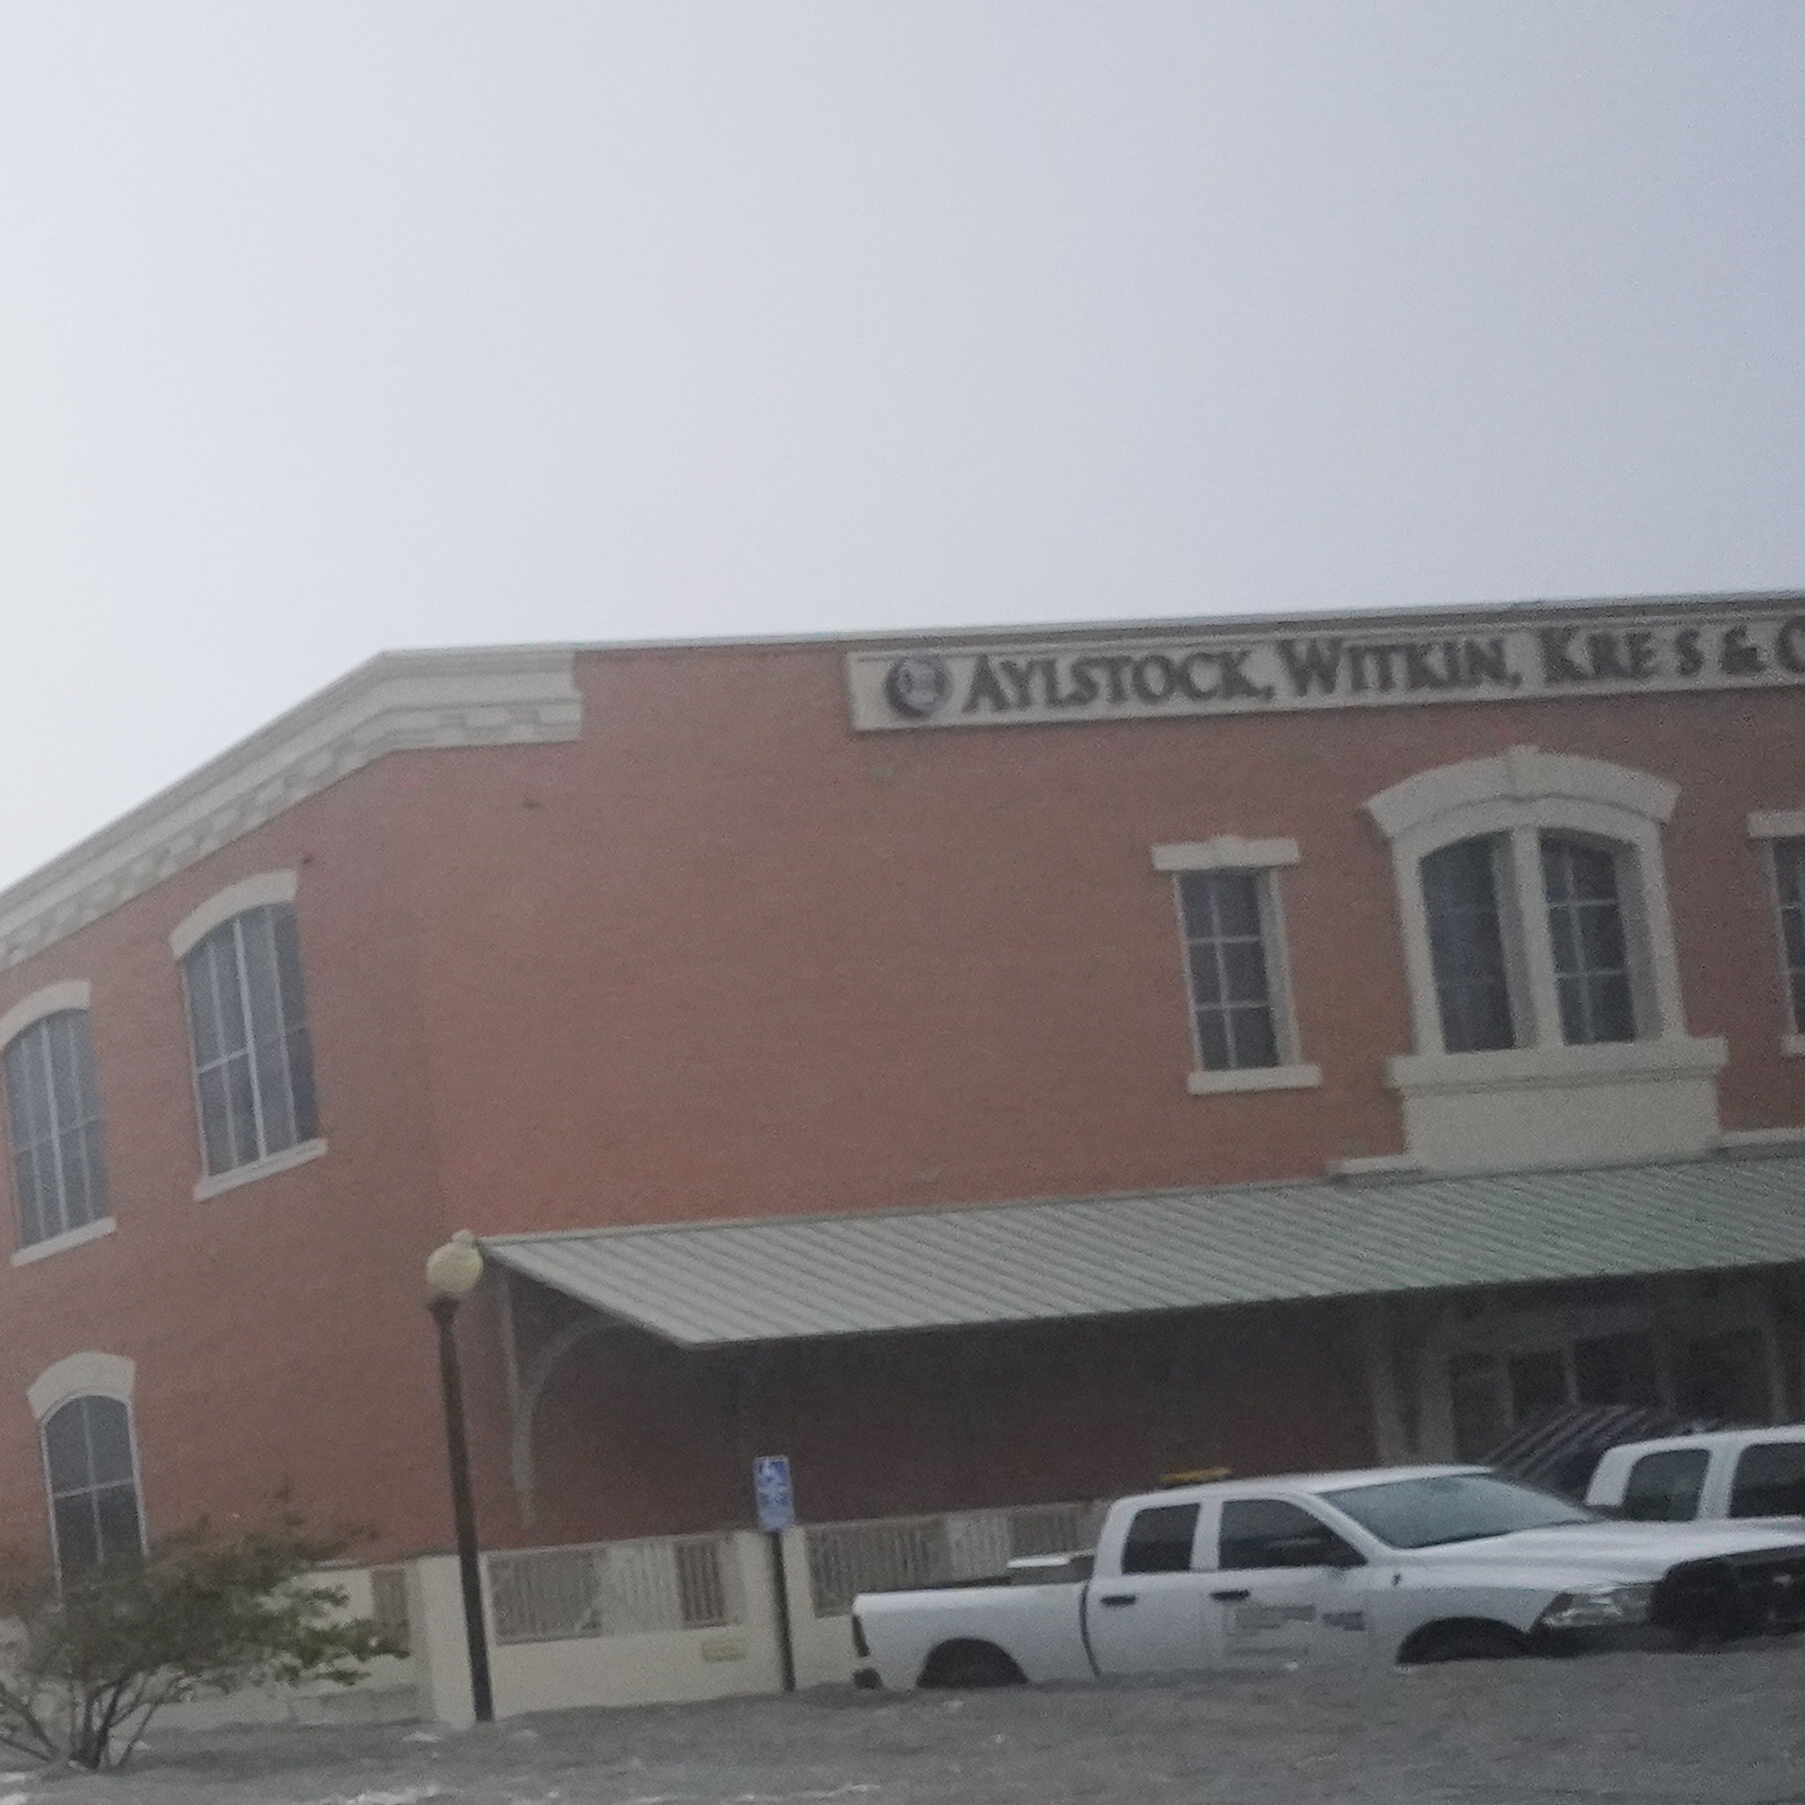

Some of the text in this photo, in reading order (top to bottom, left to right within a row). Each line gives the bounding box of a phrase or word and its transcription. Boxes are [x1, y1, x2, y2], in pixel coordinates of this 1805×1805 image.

[962, 648, 1275, 713] AYLSTOCK,
[1275, 638, 1523, 699] WITKIN,
[1538, 626, 1705, 686] KRES
[1719, 624, 1765, 674] &
